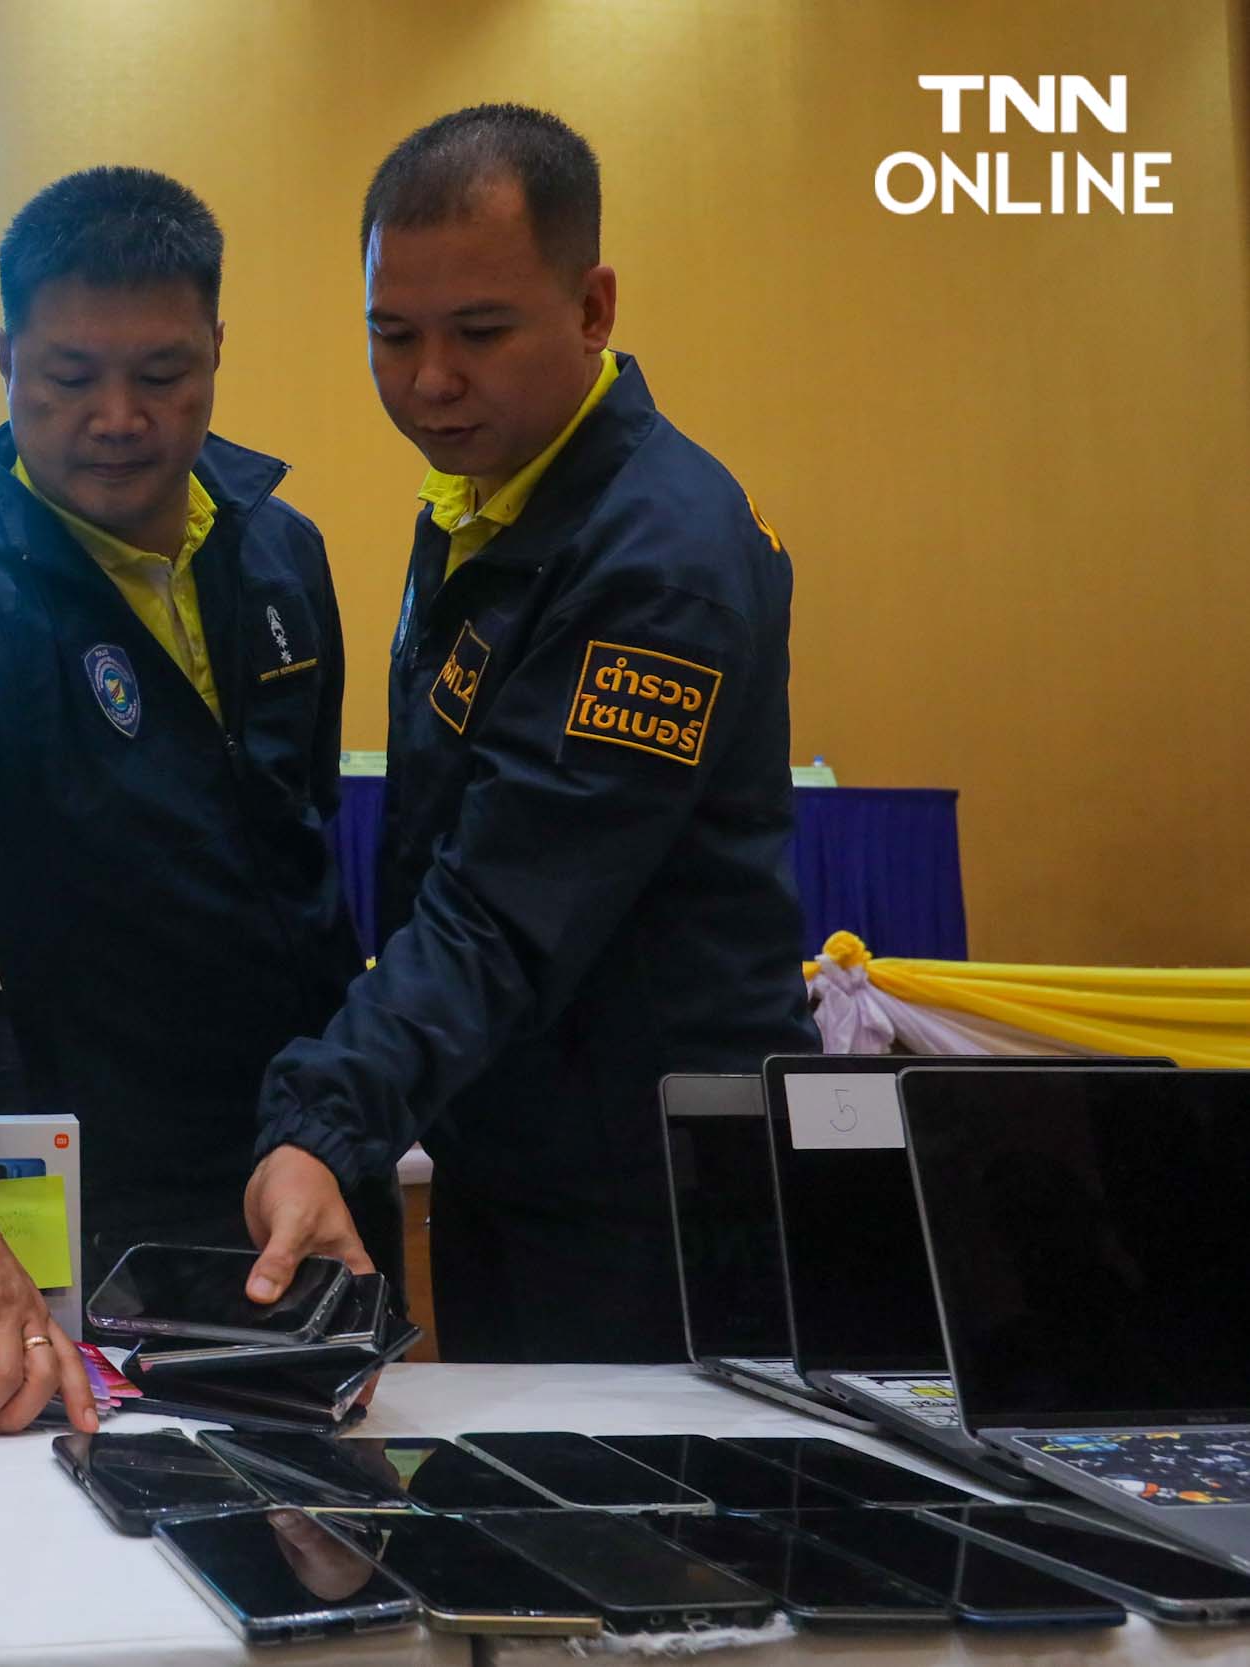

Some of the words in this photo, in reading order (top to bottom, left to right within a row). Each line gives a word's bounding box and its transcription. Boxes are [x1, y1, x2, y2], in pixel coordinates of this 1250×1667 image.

[594, 656, 703, 713] ตำรวจ
[577, 693, 703, 753] ไซเบอร์
[829, 1087, 859, 1133] 5
